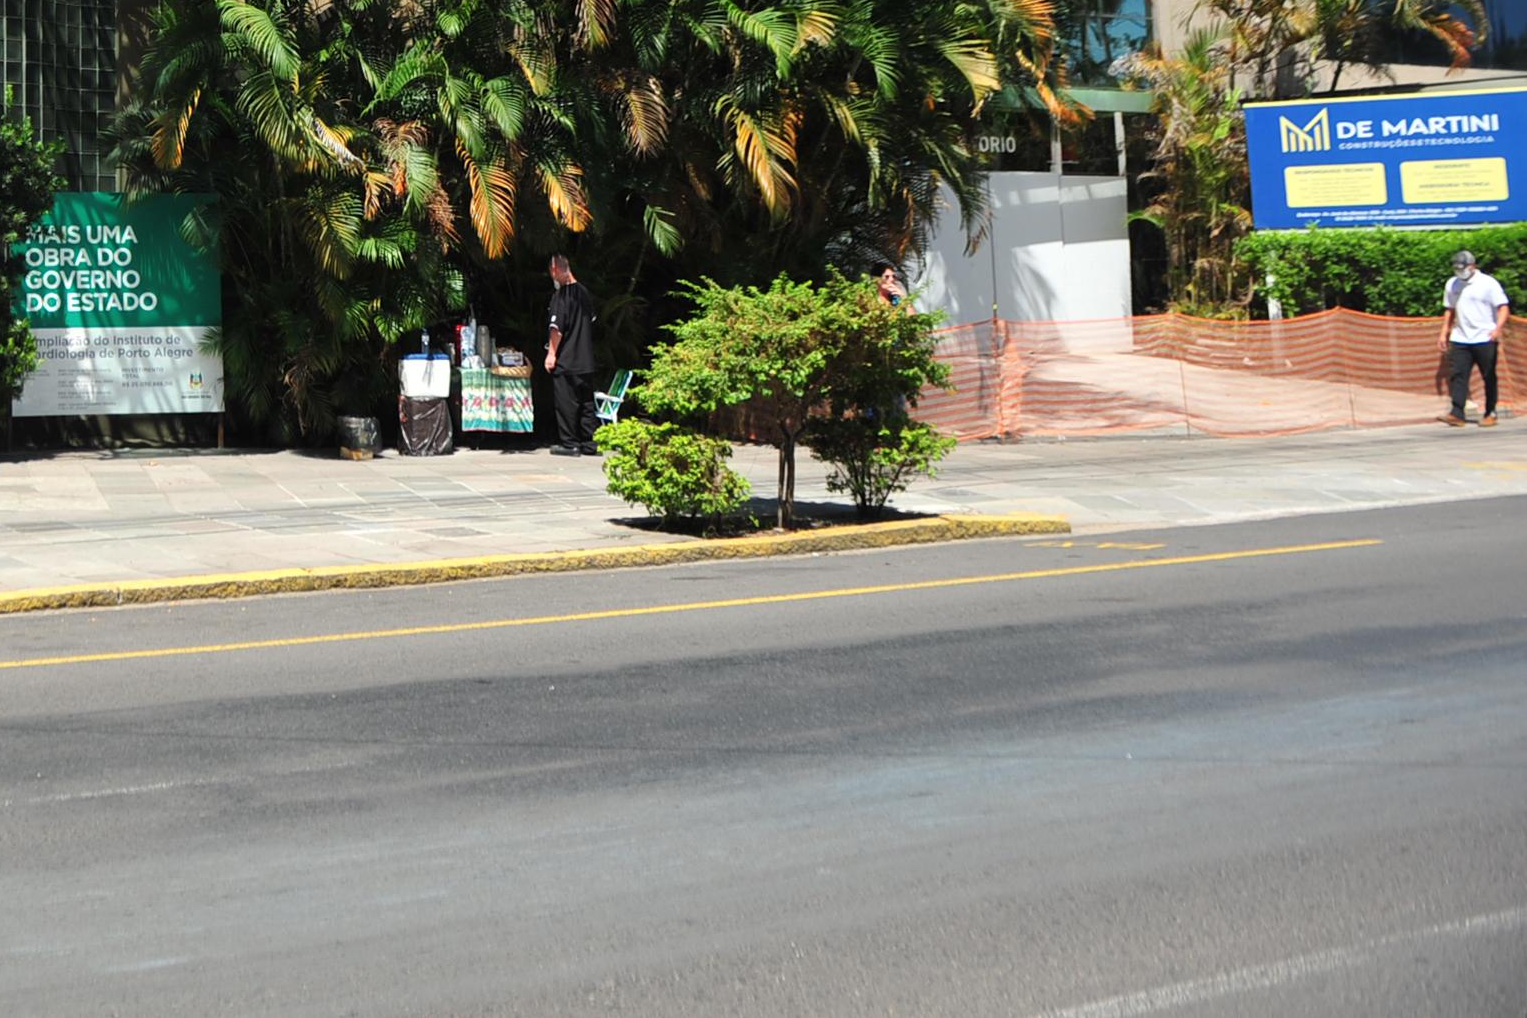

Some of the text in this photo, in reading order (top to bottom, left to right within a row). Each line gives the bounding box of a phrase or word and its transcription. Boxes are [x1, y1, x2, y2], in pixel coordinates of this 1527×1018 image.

[1336, 120, 1374, 139] DE
[1381, 113, 1500, 137] MARTINI
[86, 225, 138, 244] UMA
[25, 247, 132, 267] OBRA DO
[25, 270, 141, 289] GOVERNO
[26, 292, 158, 312] DO ESTADO
[34, 334, 181, 349] mpliação do Instituto de
[35, 346, 194, 360] ardiologia de Porto Alegre
